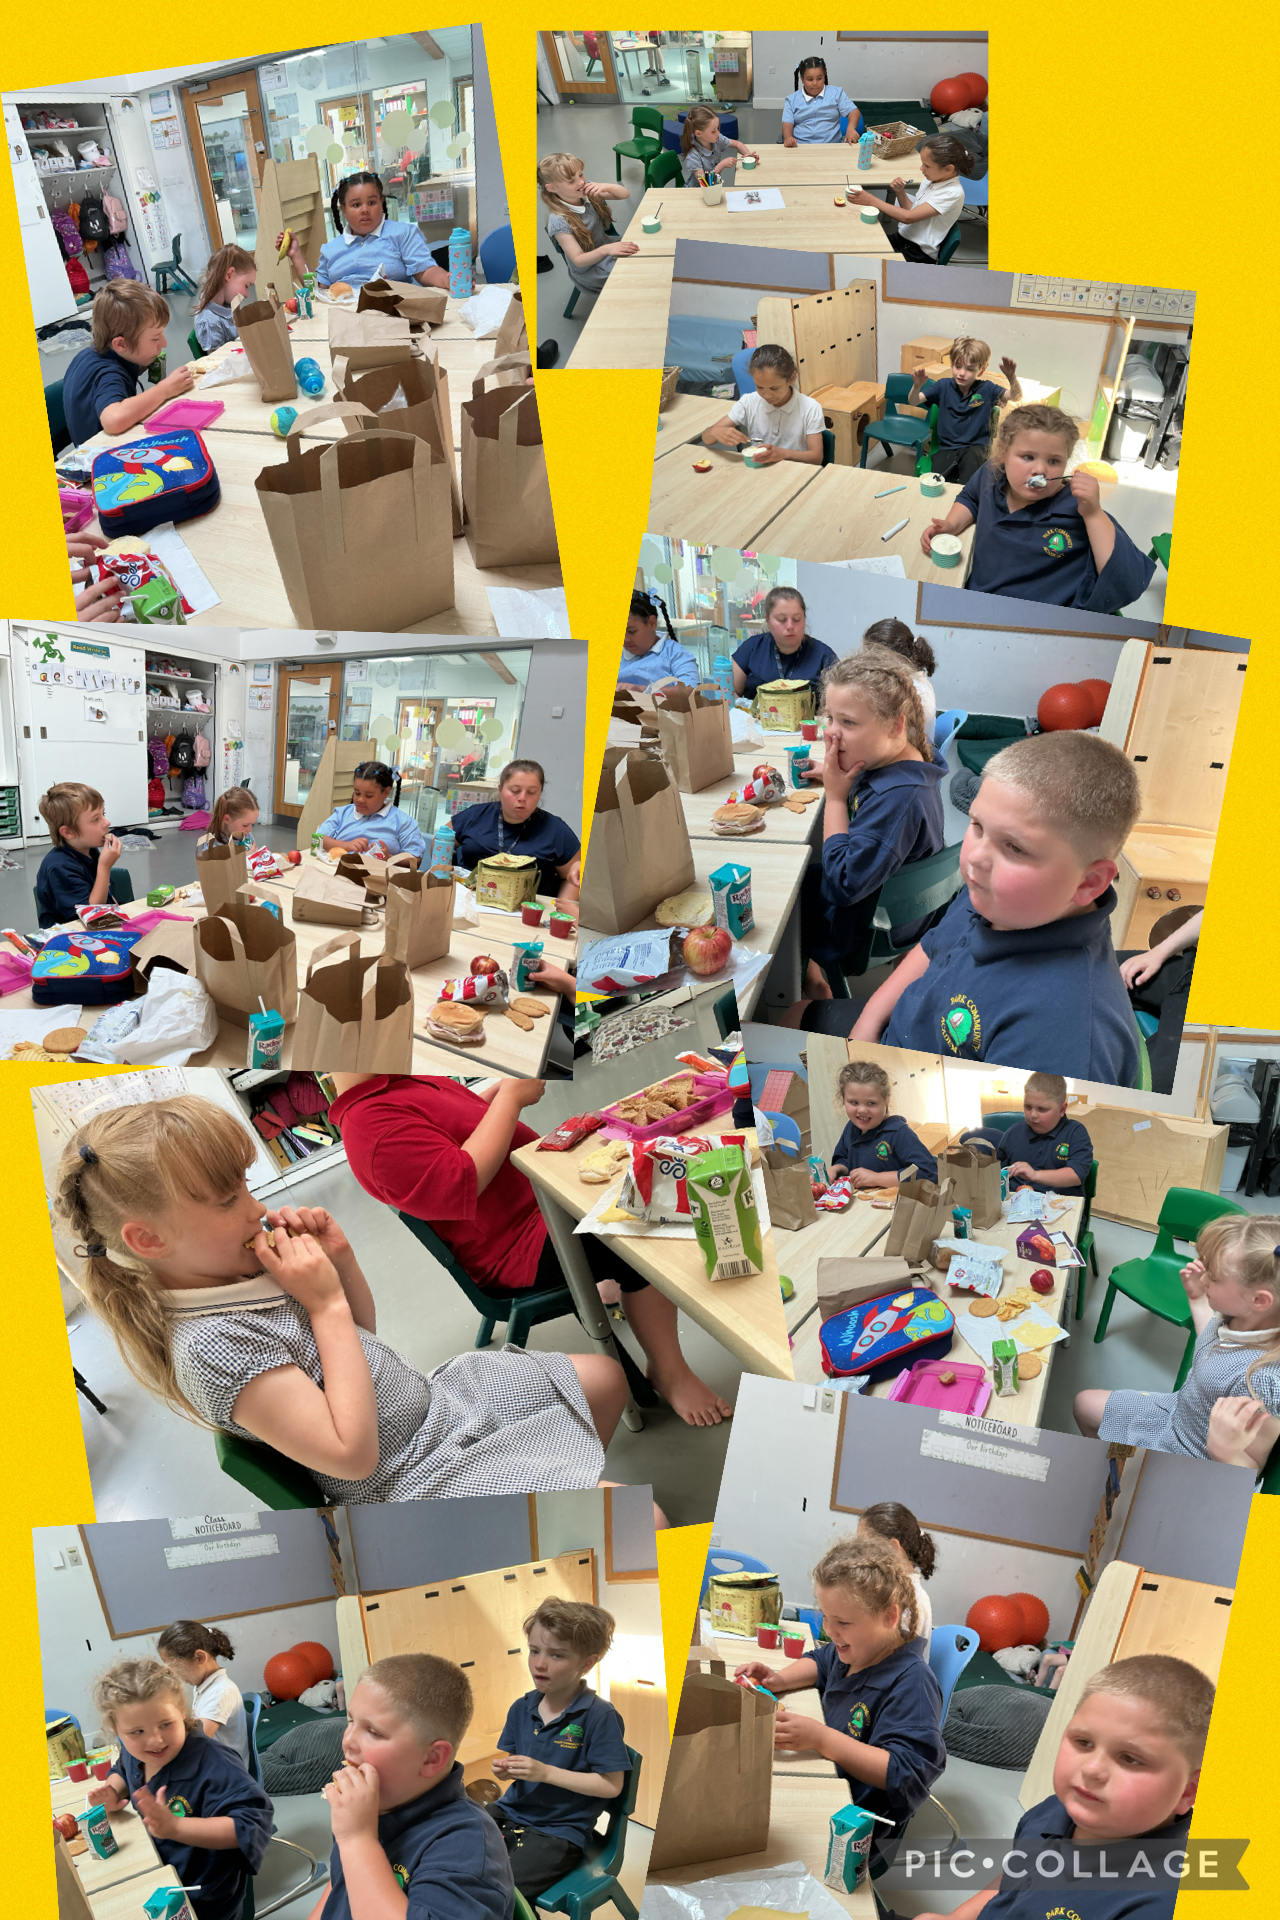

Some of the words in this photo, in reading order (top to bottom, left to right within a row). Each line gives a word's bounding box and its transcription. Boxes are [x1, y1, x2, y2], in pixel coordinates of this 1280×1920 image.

[138, 436, 189, 448] Whoosh
[950, 994, 967, 1005] PARK
[966, 999, 981, 1051] COMMUNITY
[837, 1310, 860, 1346] Whoosh
[965, 1416, 1018, 1438] NOTICEBOARD
[966, 1441, 978, 1451] Our
[204, 1515, 226, 1525] Class
[195, 1521, 242, 1535] NOTICEBOARD
[1046, 1907, 1066, 1920] PARK
